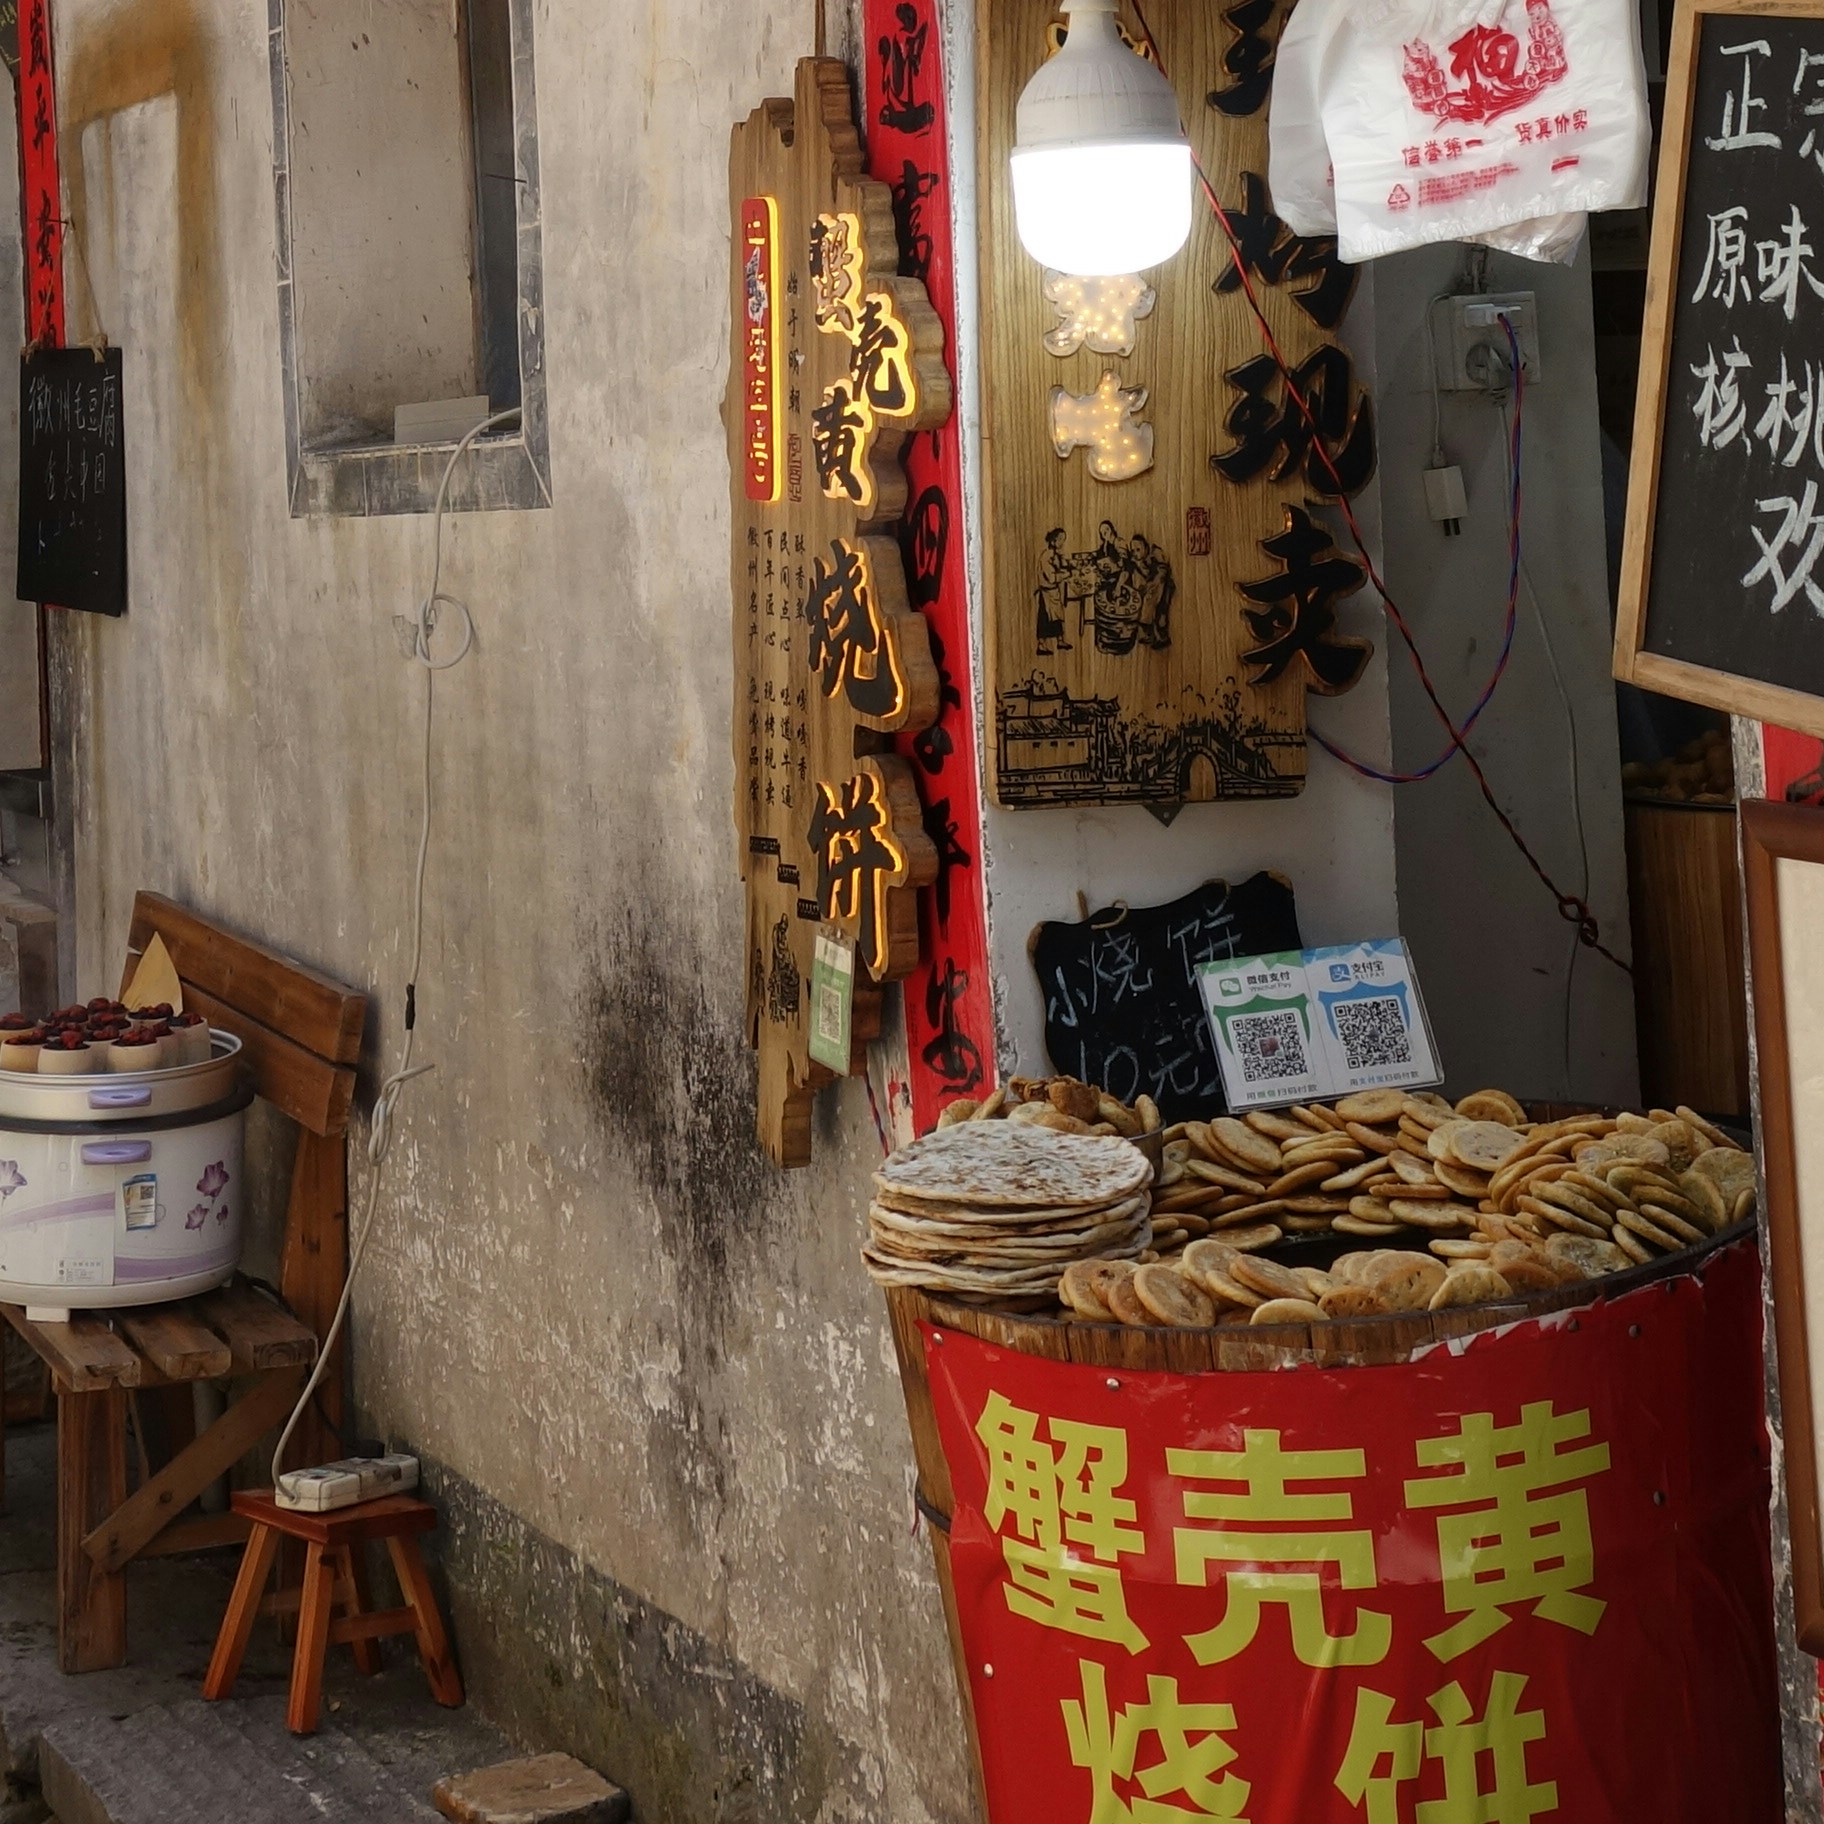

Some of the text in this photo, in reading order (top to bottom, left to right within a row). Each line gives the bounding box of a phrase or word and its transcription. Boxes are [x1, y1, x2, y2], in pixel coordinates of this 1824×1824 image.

[1514, 108, 1588, 146] 货真价实
[1401, 137, 1485, 168] 信誉第一
[1246, 970, 1291, 986] 微信支付
[1350, 959, 1385, 975] 支付宝
[1349, 1070, 1420, 1087] 用支付宝扫码付款
[1245, 1083, 1319, 1101] 用微信扫码付款
[975, 1388, 1614, 1668] 蟹壳黄
[1059, 1658, 1561, 1824] 烧饼
